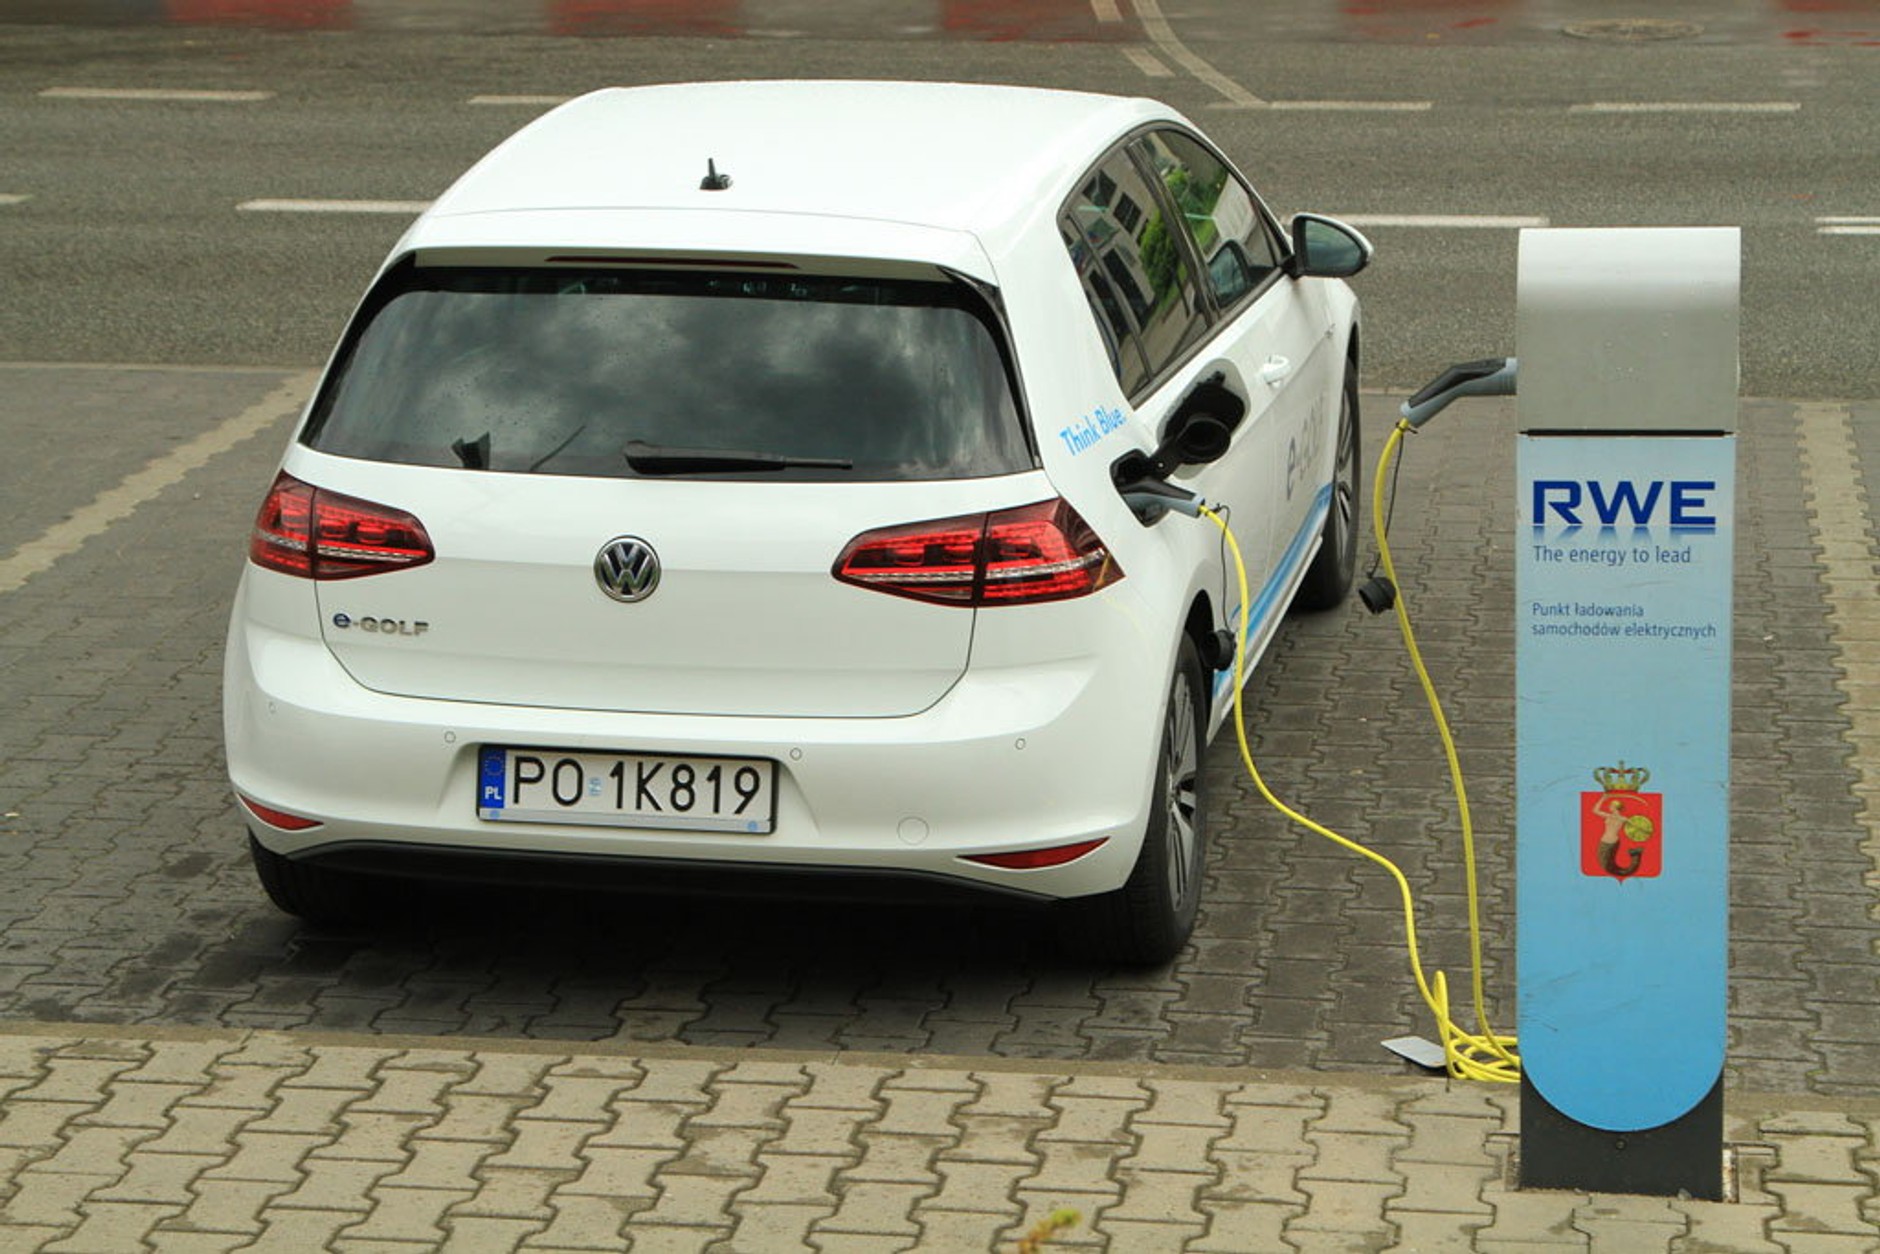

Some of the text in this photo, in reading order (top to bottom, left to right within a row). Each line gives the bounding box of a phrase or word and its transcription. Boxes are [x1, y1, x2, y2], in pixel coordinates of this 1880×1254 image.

[1060, 415, 1101, 456] Think
[1533, 480, 1716, 525] RWE
[1533, 545, 1691, 567] The energy to lead
[1532, 602, 1644, 617] Punkt ładowania
[332, 613, 429, 636] e-GOLF
[1532, 622, 1716, 640] samochodów elektrycznych
[484, 786, 502, 800] PL
[513, 756, 760, 815] PO 1K819
